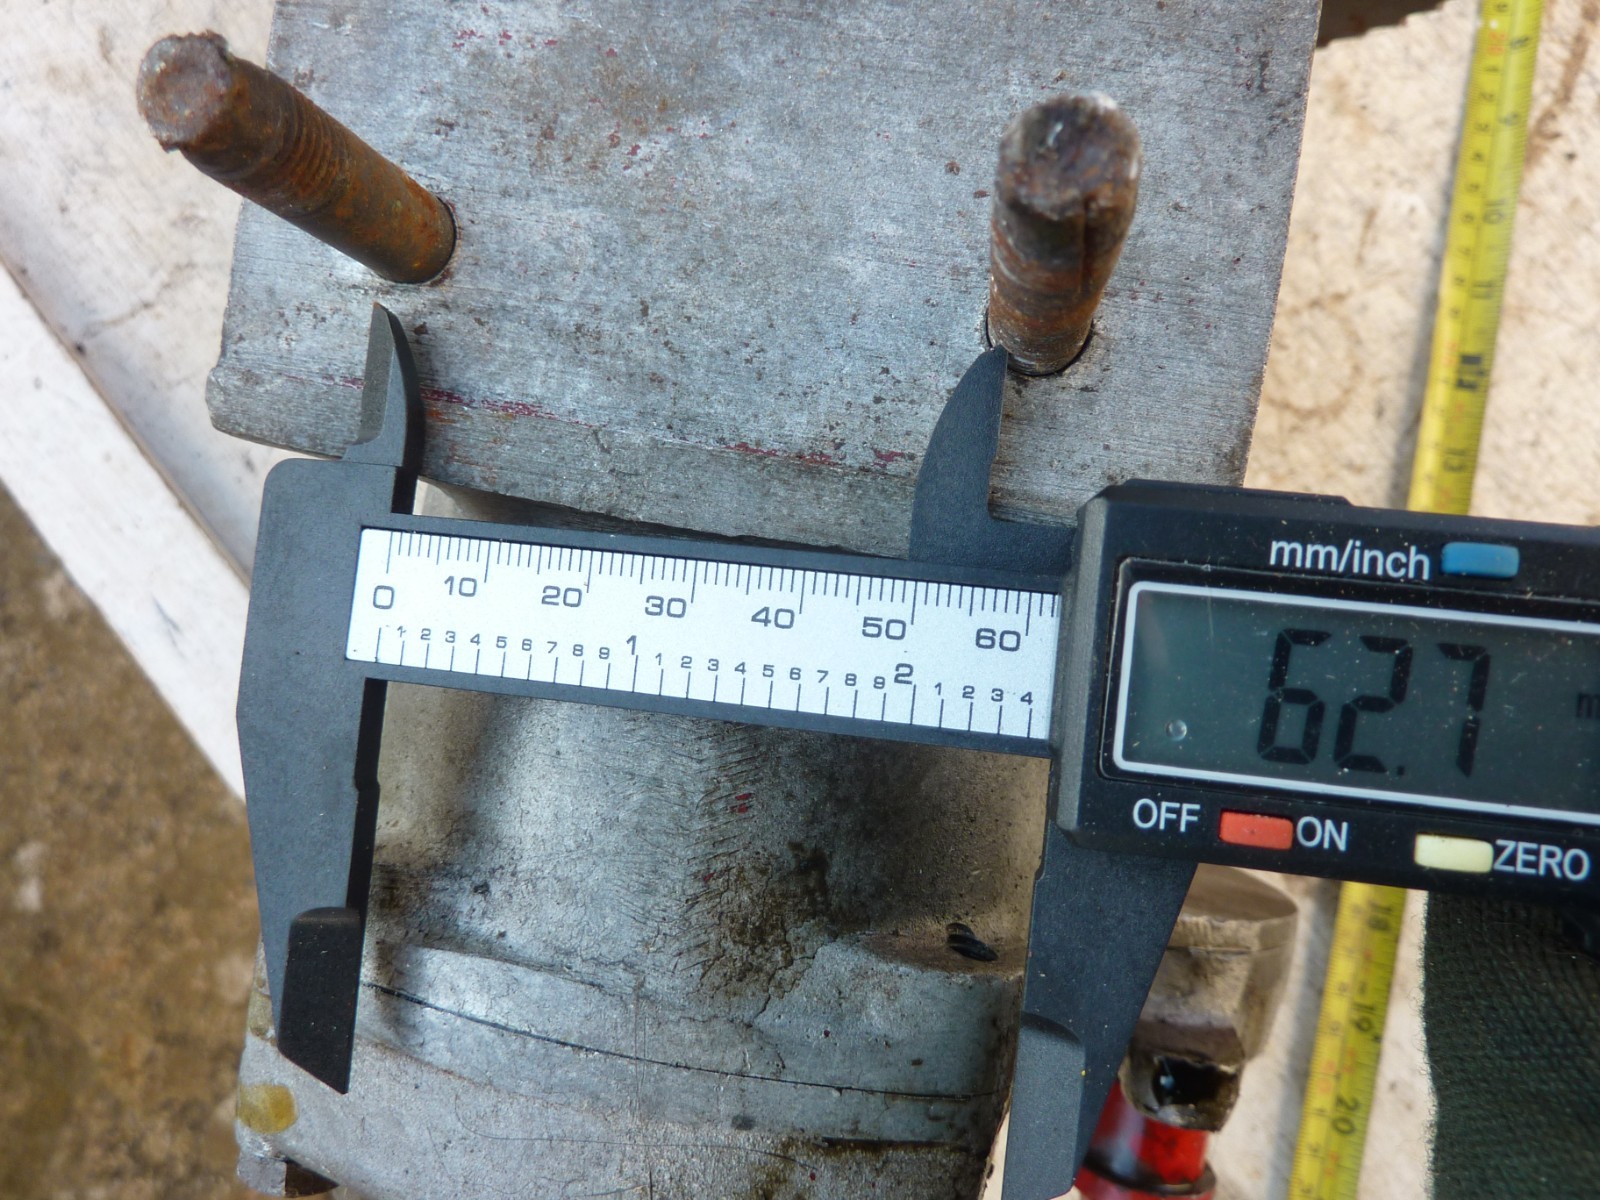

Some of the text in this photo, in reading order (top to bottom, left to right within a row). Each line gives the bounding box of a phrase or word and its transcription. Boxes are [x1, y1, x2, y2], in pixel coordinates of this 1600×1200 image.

[1269, 540, 1431, 581] mm/inch
[372, 575, 1022, 653] 0 10 20 30 40 50 60
[419, 627, 432, 641] 2
[444, 630, 456, 644] 3
[469, 633, 481, 647] 4
[495, 635, 508, 649] 5
[521, 638, 533, 652] 6
[546, 640, 558, 655] 7
[572, 643, 584, 658] 8
[598, 646, 611, 661] 9
[625, 634, 638, 656] 1
[654, 652, 663, 667] 1
[680, 655, 693, 670] 2
[707, 657, 720, 672] 3
[733, 661, 747, 676] 4
[762, 663, 775, 678] 5
[789, 666, 802, 681] 6
[816, 669, 829, 684] 7
[844, 672, 858, 687] 8
[893, 662, 914, 686] 2
[933, 681, 943, 696] 1
[961, 684, 976, 700] 2
[990, 687, 1005, 703] 3
[1019, 691, 1034, 706] 4
[1257, 627, 1491, 778] 62.7
[1132, 798, 1590, 881] OFF ON ZERO
[1332, 1095, 1359, 1135] 20
